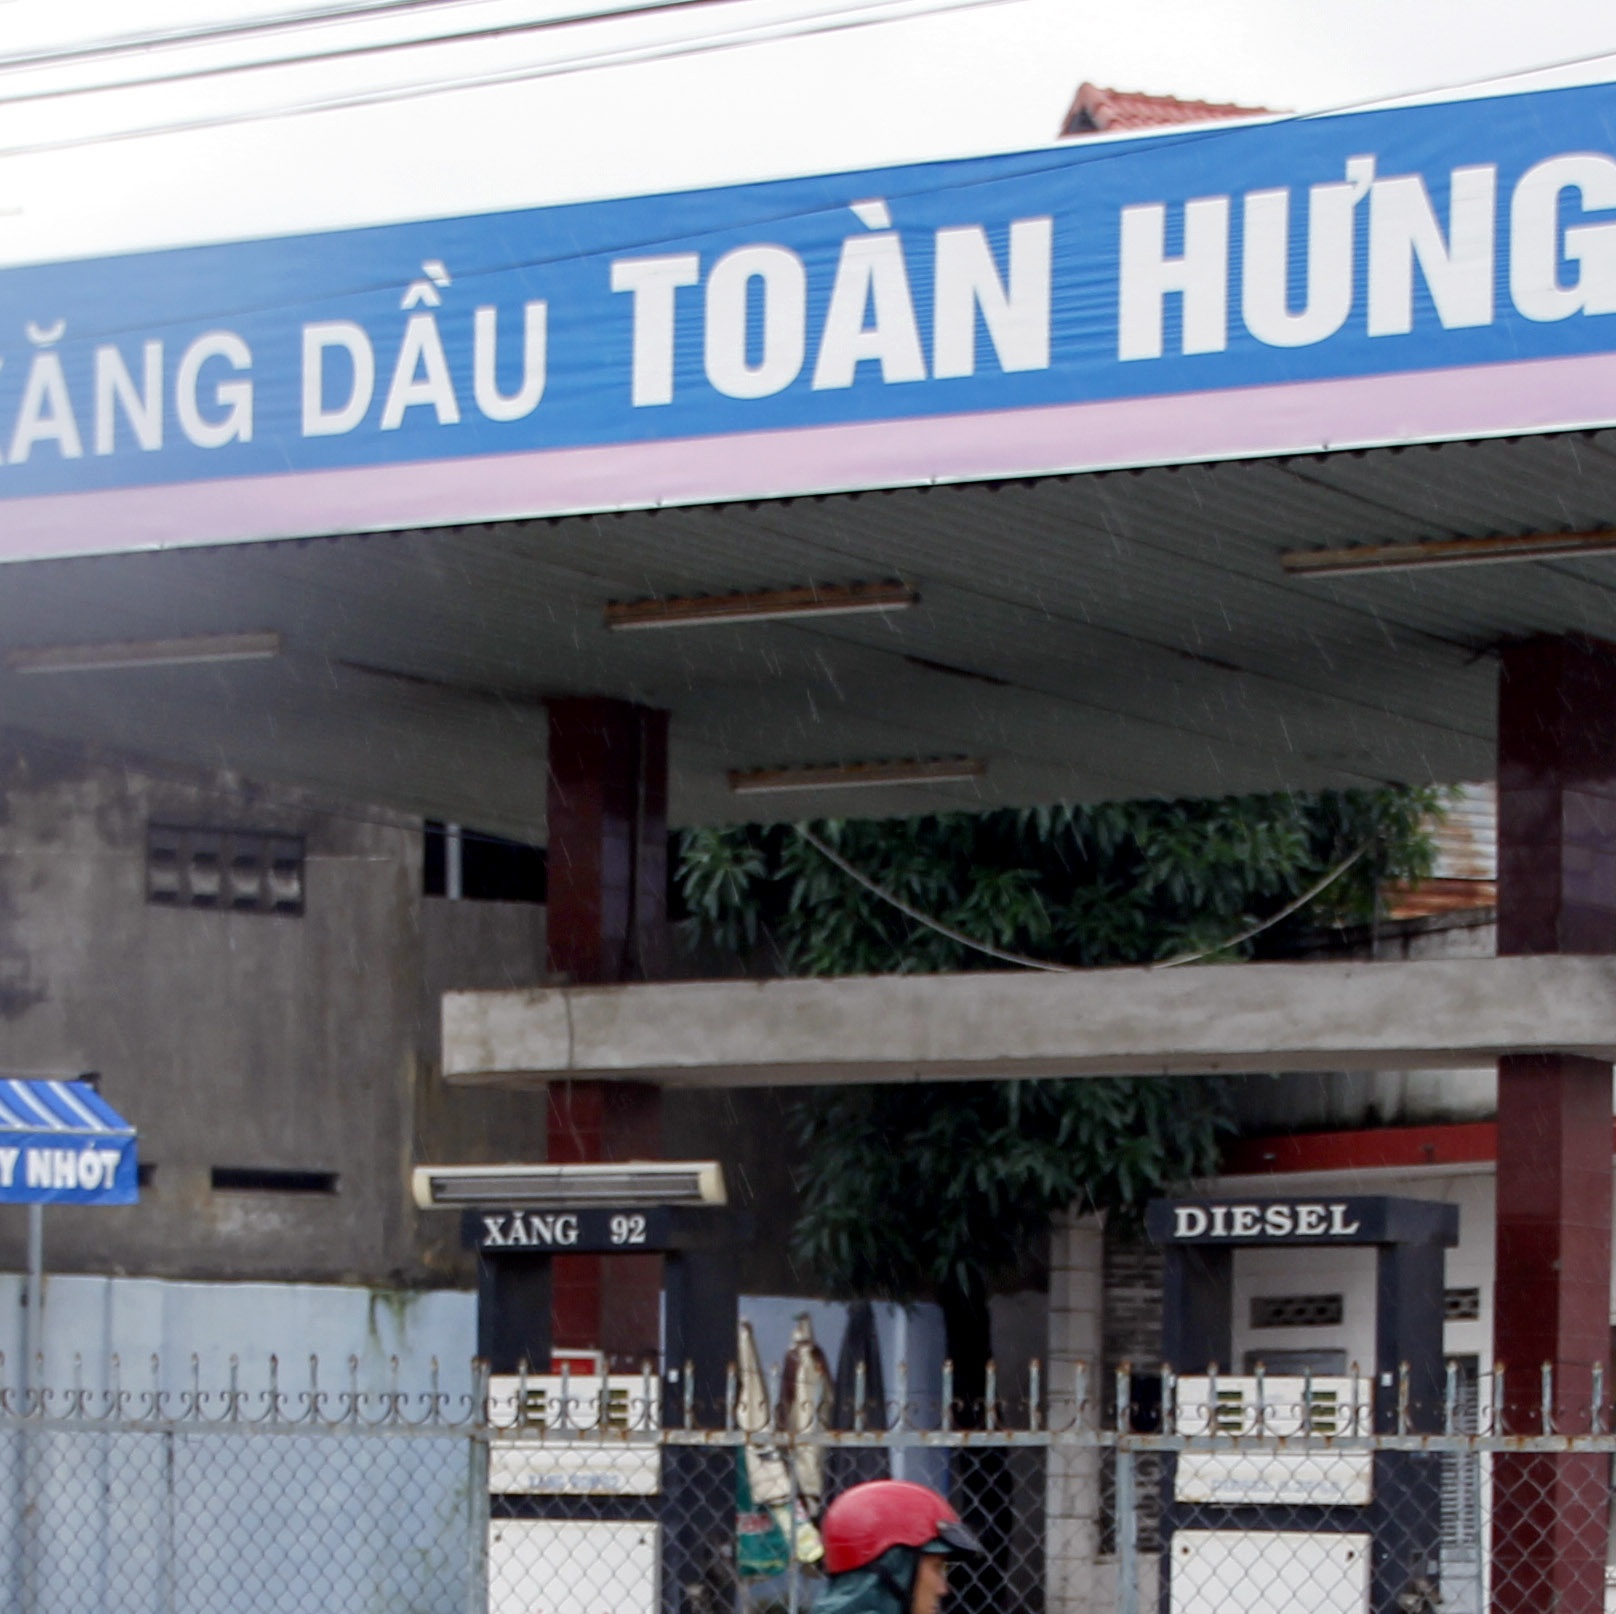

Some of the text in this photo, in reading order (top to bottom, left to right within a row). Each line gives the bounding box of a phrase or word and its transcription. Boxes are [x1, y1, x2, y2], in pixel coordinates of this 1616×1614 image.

[301, 259, 549, 439] DẦU
[610, 200, 1054, 409] TOÀN
[482, 1211, 647, 1249] XĂNG 92
[1172, 1203, 1361, 1239] DIESEL
